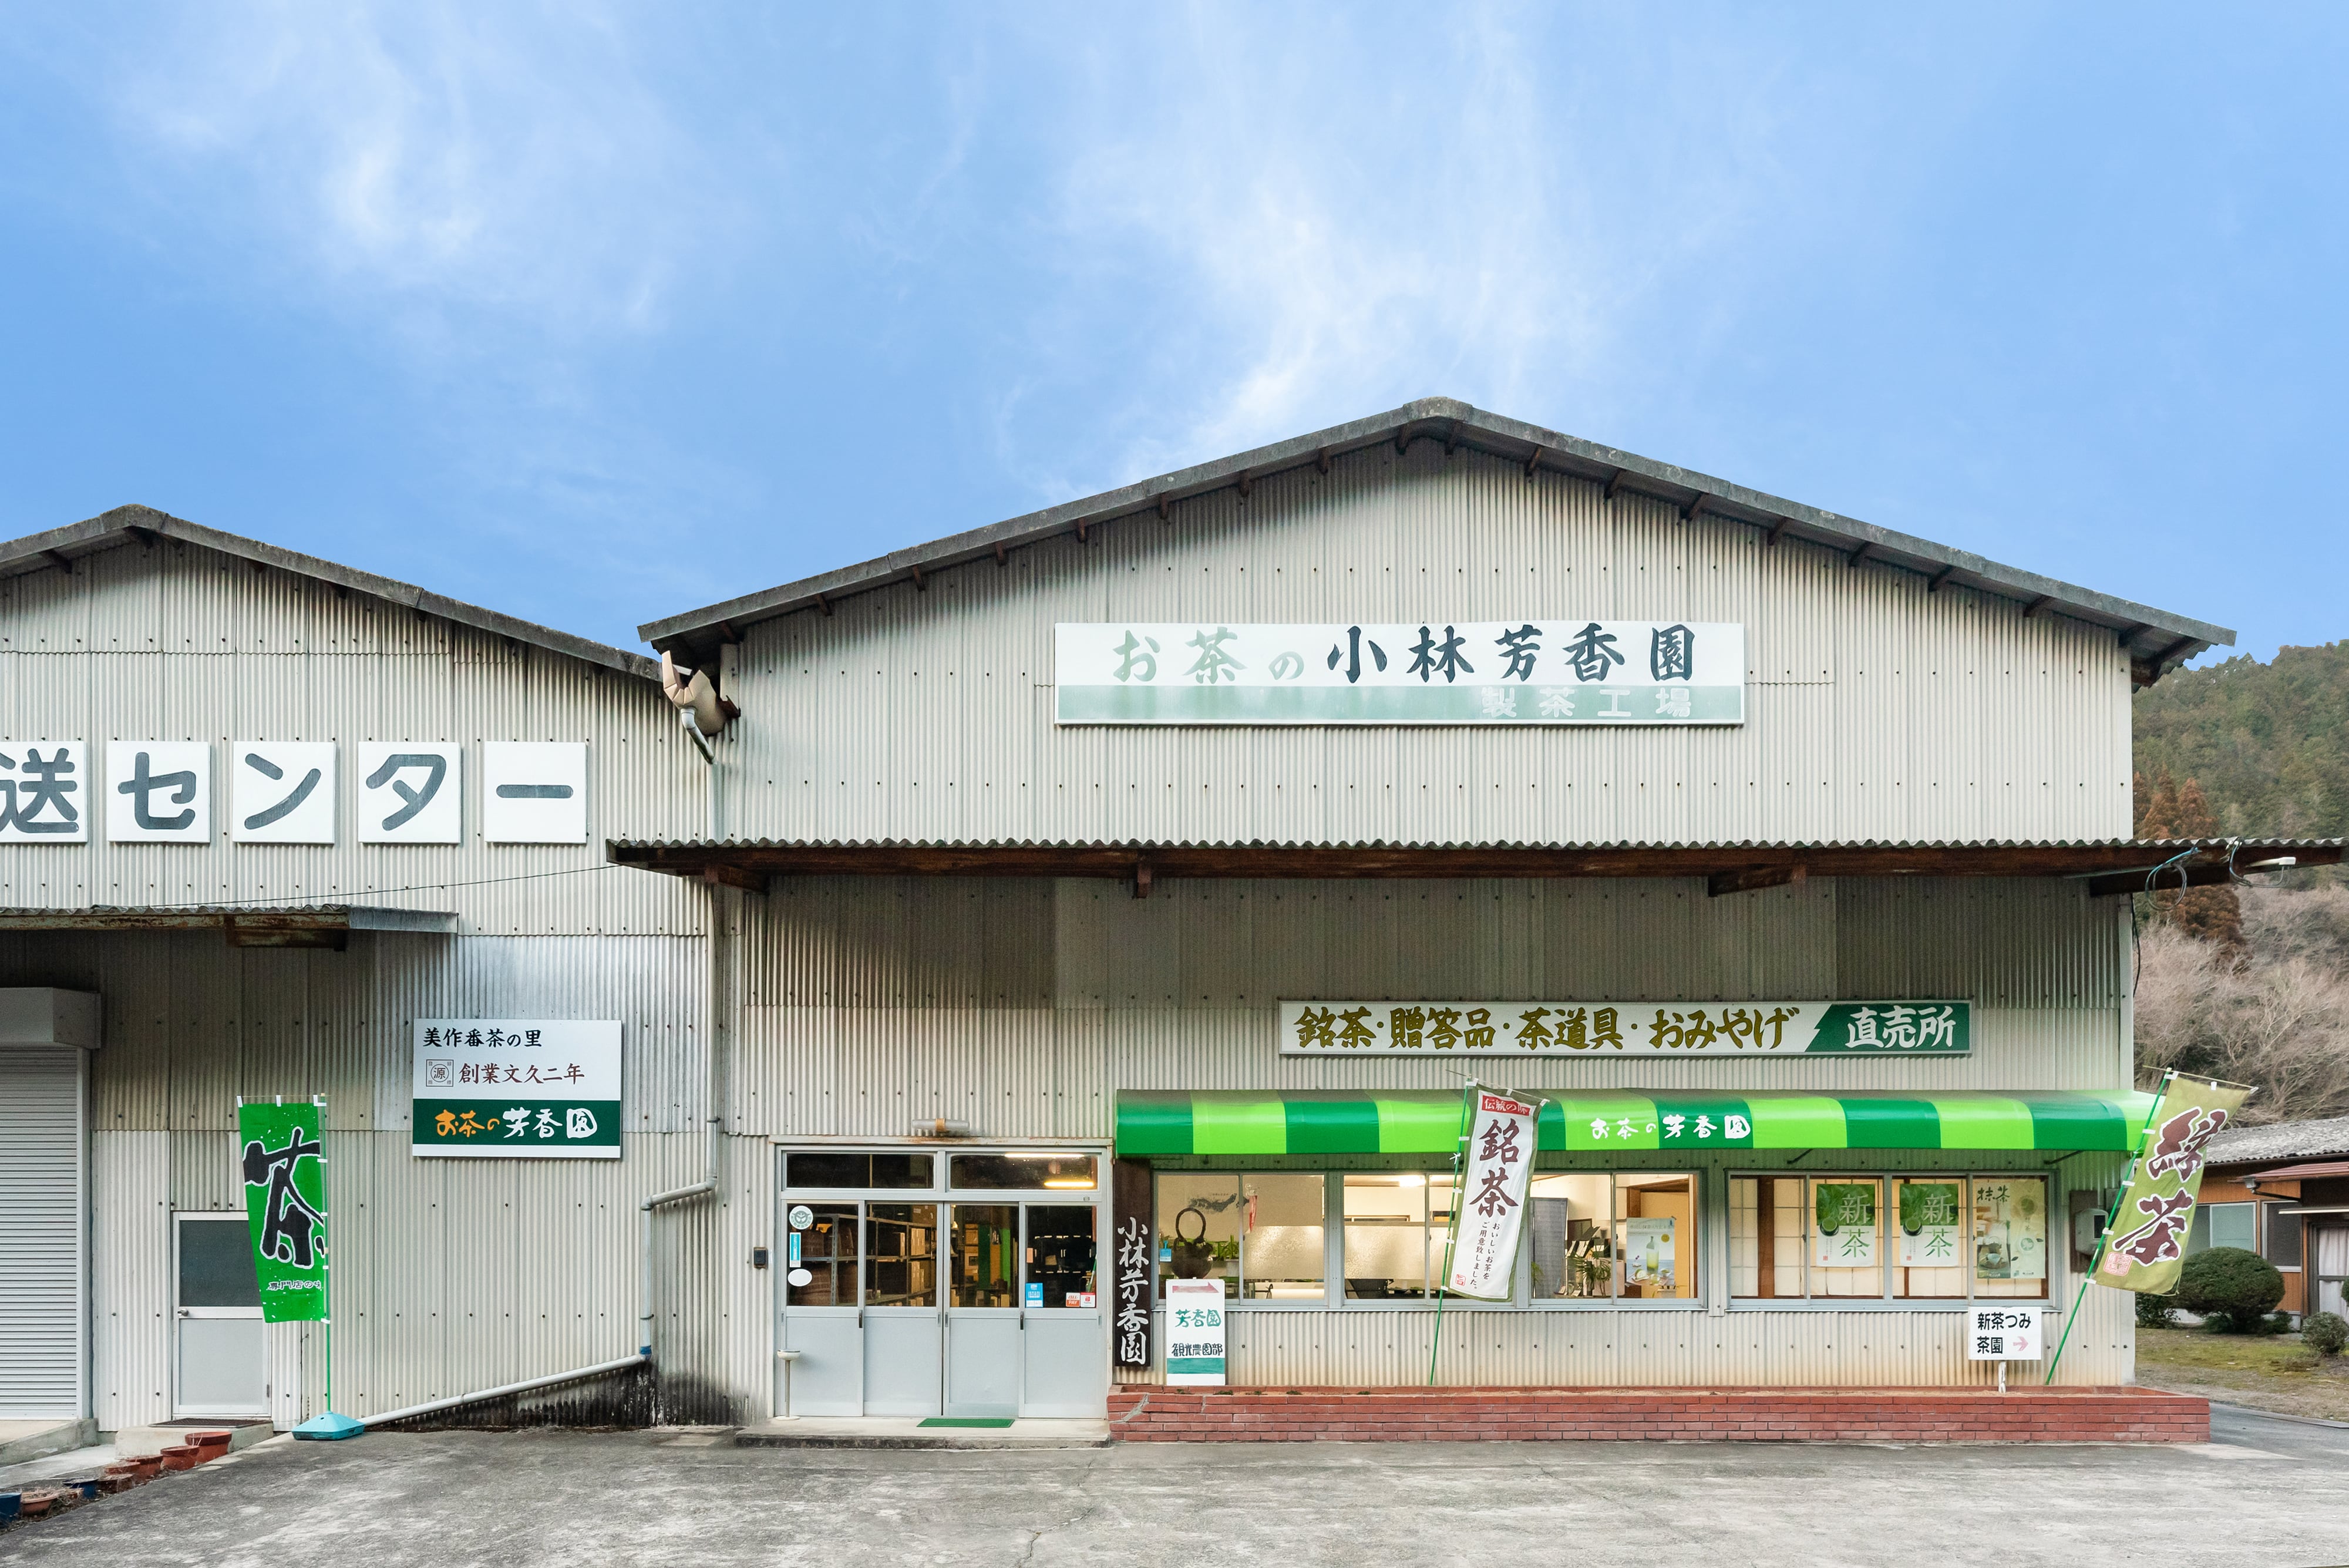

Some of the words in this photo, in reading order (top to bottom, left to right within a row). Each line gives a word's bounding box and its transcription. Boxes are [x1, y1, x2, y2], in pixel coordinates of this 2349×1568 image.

[1113, 623, 1694, 683] お茶の小林芳香園
[1481, 686, 1691, 718] 製茶工場
[0, 748, 573, 833] 送センター
[422, 1027, 542, 1048] 美作番茶の里
[1845, 1005, 1956, 1049] 直売所
[434, 1067, 446, 1079] 源
[458, 1062, 585, 1085] 創業文久二年
[435, 1106, 598, 1139] お茶の芳香園
[1590, 1114, 1751, 1139] お茶の芳香園
[1469, 1118, 1520, 1219] 銘茶
[1977, 1185, 2010, 1203] 抹茶
[1838, 1193, 1870, 1257] 新茶
[1923, 1193, 1954, 1257] 新茶
[1483, 1223, 1500, 1280] おいしいお茶を
[1117, 1217, 1149, 1365] 小林芳香園
[1174, 1308, 1221, 1328] 芳香園
[1978, 1312, 2031, 1330] 新茶つみ
[1172, 1342, 1223, 1357] 観光農園部
[1977, 1336, 2003, 1354] 茶園
